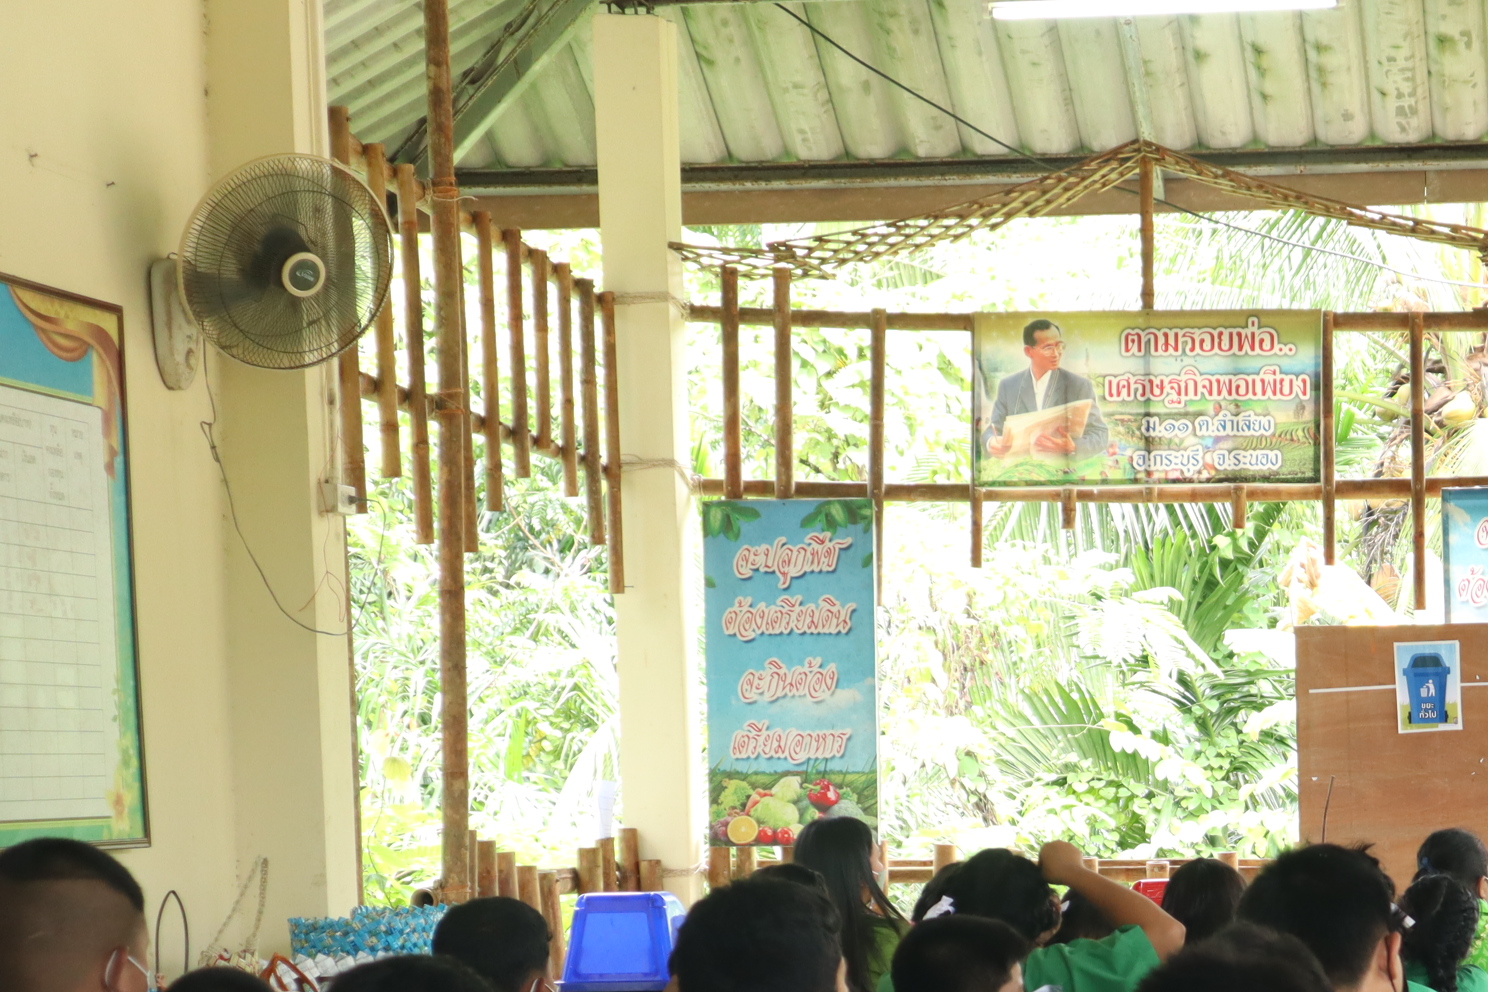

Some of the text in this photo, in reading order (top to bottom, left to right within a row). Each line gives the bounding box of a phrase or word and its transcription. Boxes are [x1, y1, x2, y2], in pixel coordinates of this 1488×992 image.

[1123, 319, 1295, 355] ตามรอยพ่อ..
[1106, 368, 1309, 405] เศรษฐกิจพอเพียง
[1144, 411, 1273, 436] ม.๑๑ ต.ลำเลียง
[1135, 450, 1280, 473] อ.กระบุรี จ.ระนอง
[736, 533, 850, 586] จะปลูกพืช
[724, 596, 853, 640] ต้องเตรียมดิน
[739, 659, 837, 702] จะกินต้อง
[731, 722, 848, 763] เตรียมอาหาร
